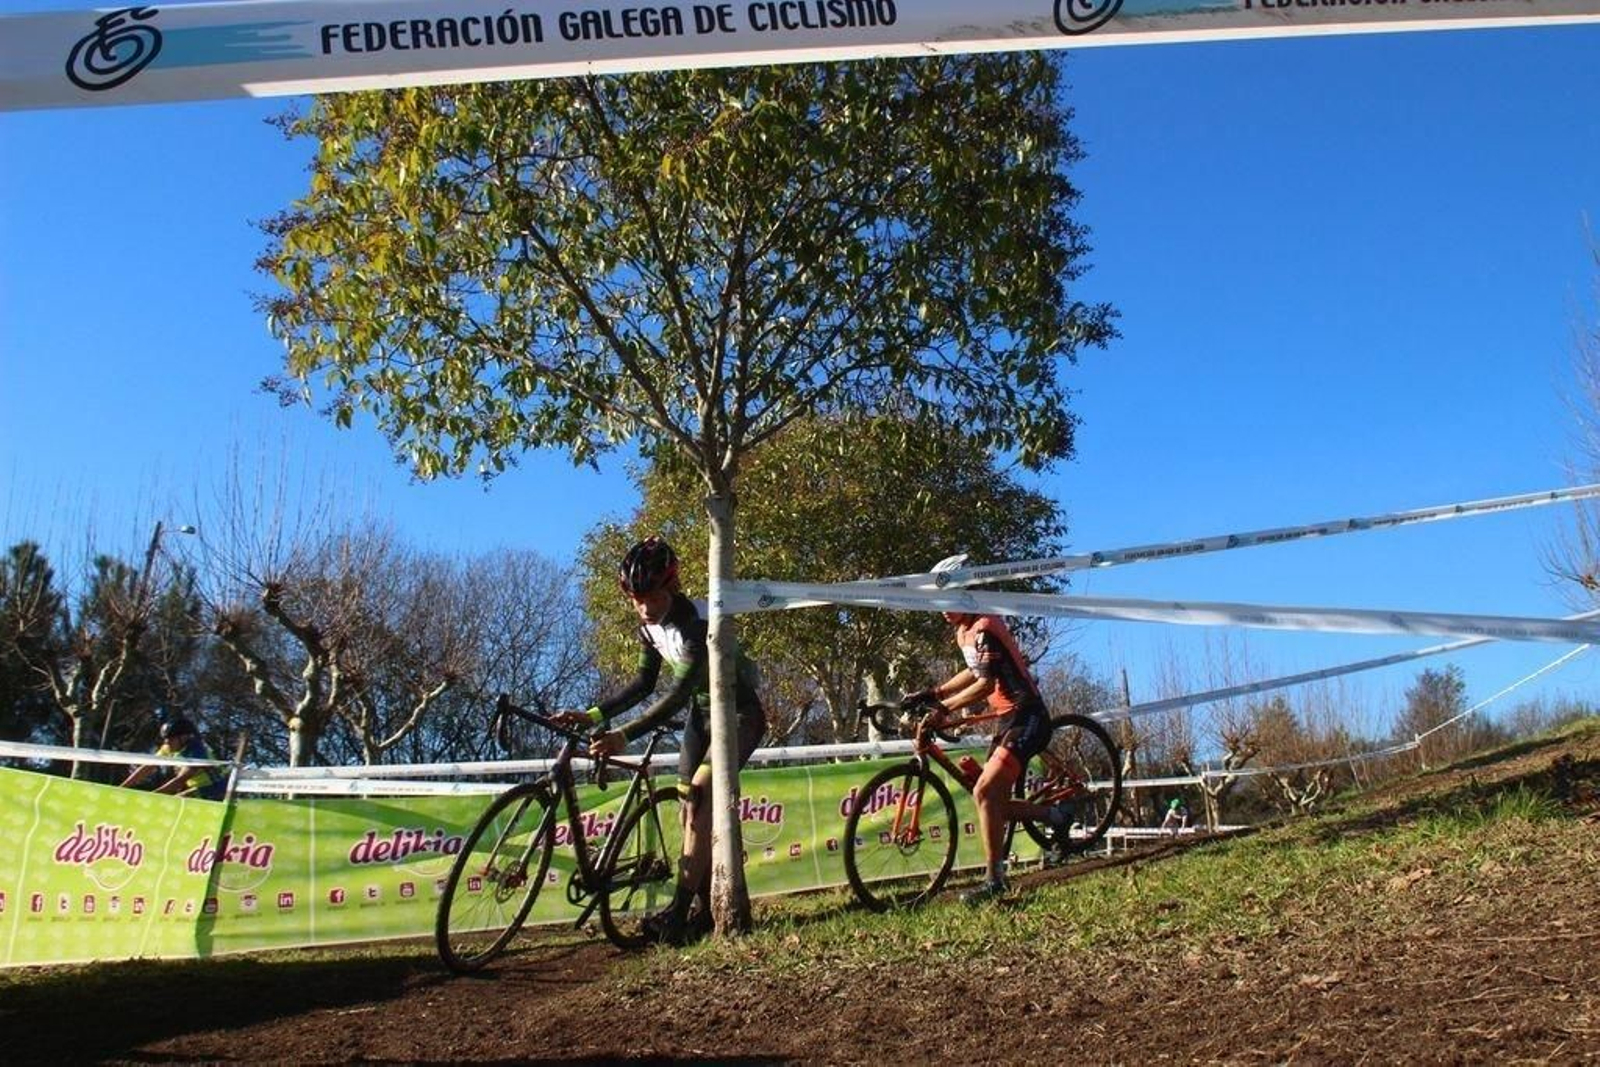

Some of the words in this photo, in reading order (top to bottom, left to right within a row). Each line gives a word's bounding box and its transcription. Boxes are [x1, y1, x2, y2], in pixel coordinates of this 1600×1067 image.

[320, 8, 544, 54] FEDERACIÓN
[558, 6, 685, 41] GALEGA
[693, 4, 737, 34] DE
[747, 0, 898, 32] CICLISMO
[349, 829, 463, 865] delikia
